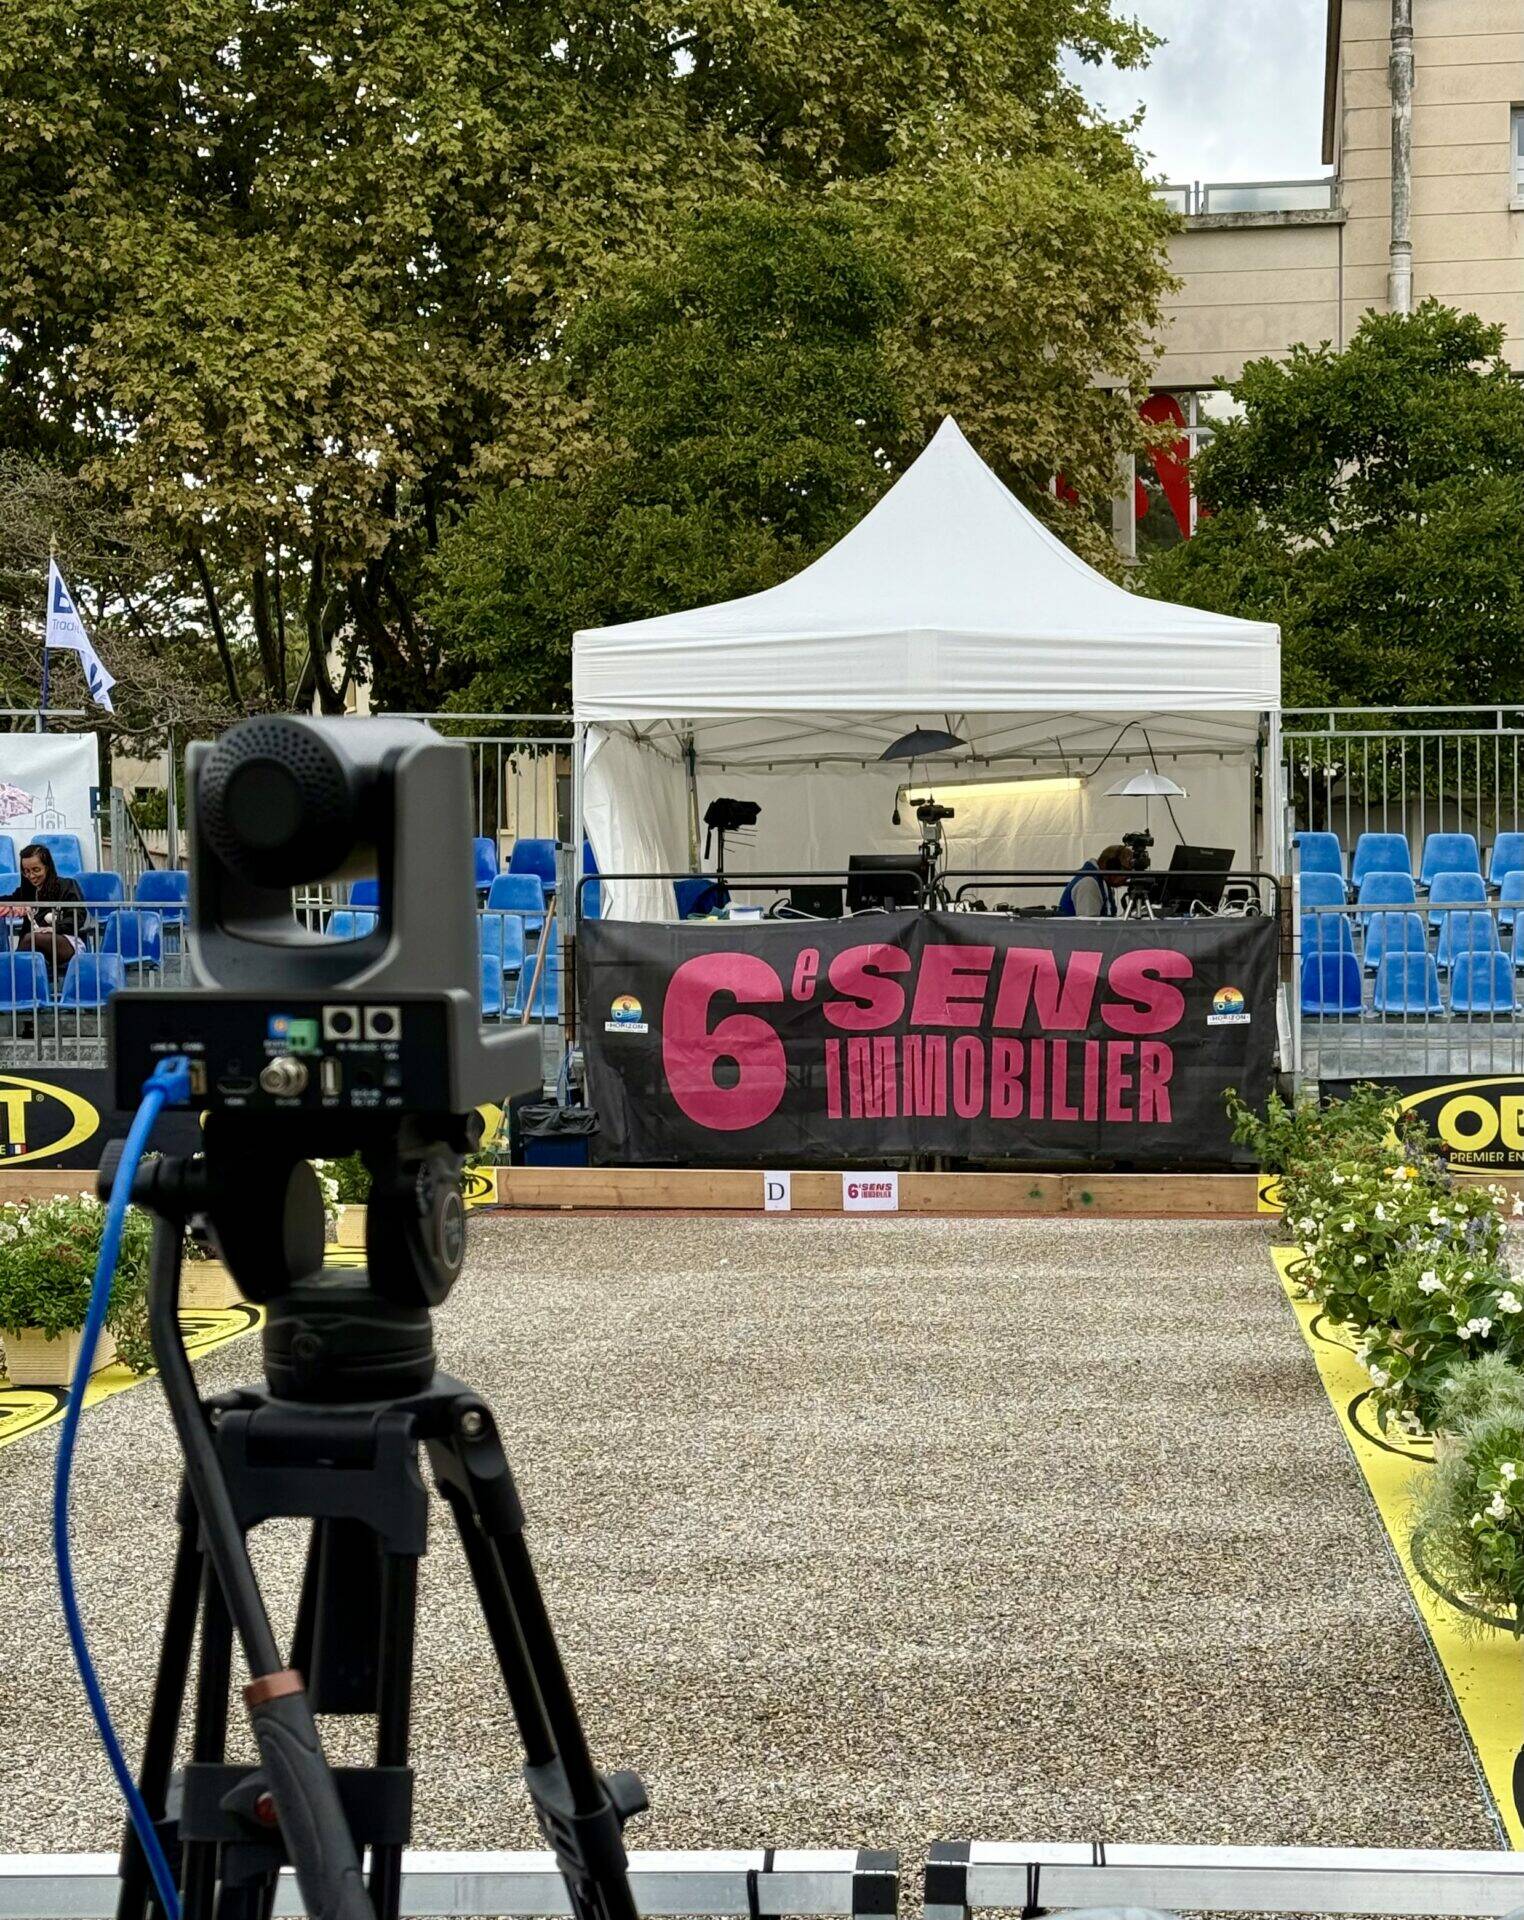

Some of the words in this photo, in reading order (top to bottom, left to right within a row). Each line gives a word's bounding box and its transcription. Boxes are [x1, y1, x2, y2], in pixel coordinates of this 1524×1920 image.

[823, 944, 1194, 1034] SENS
[825, 1034, 1173, 1123] IMMOBILIER
[1449, 1151, 1505, 1163] PREMIER
[767, 1182, 785, 1201] D
[861, 1183, 893, 1191] SENS
